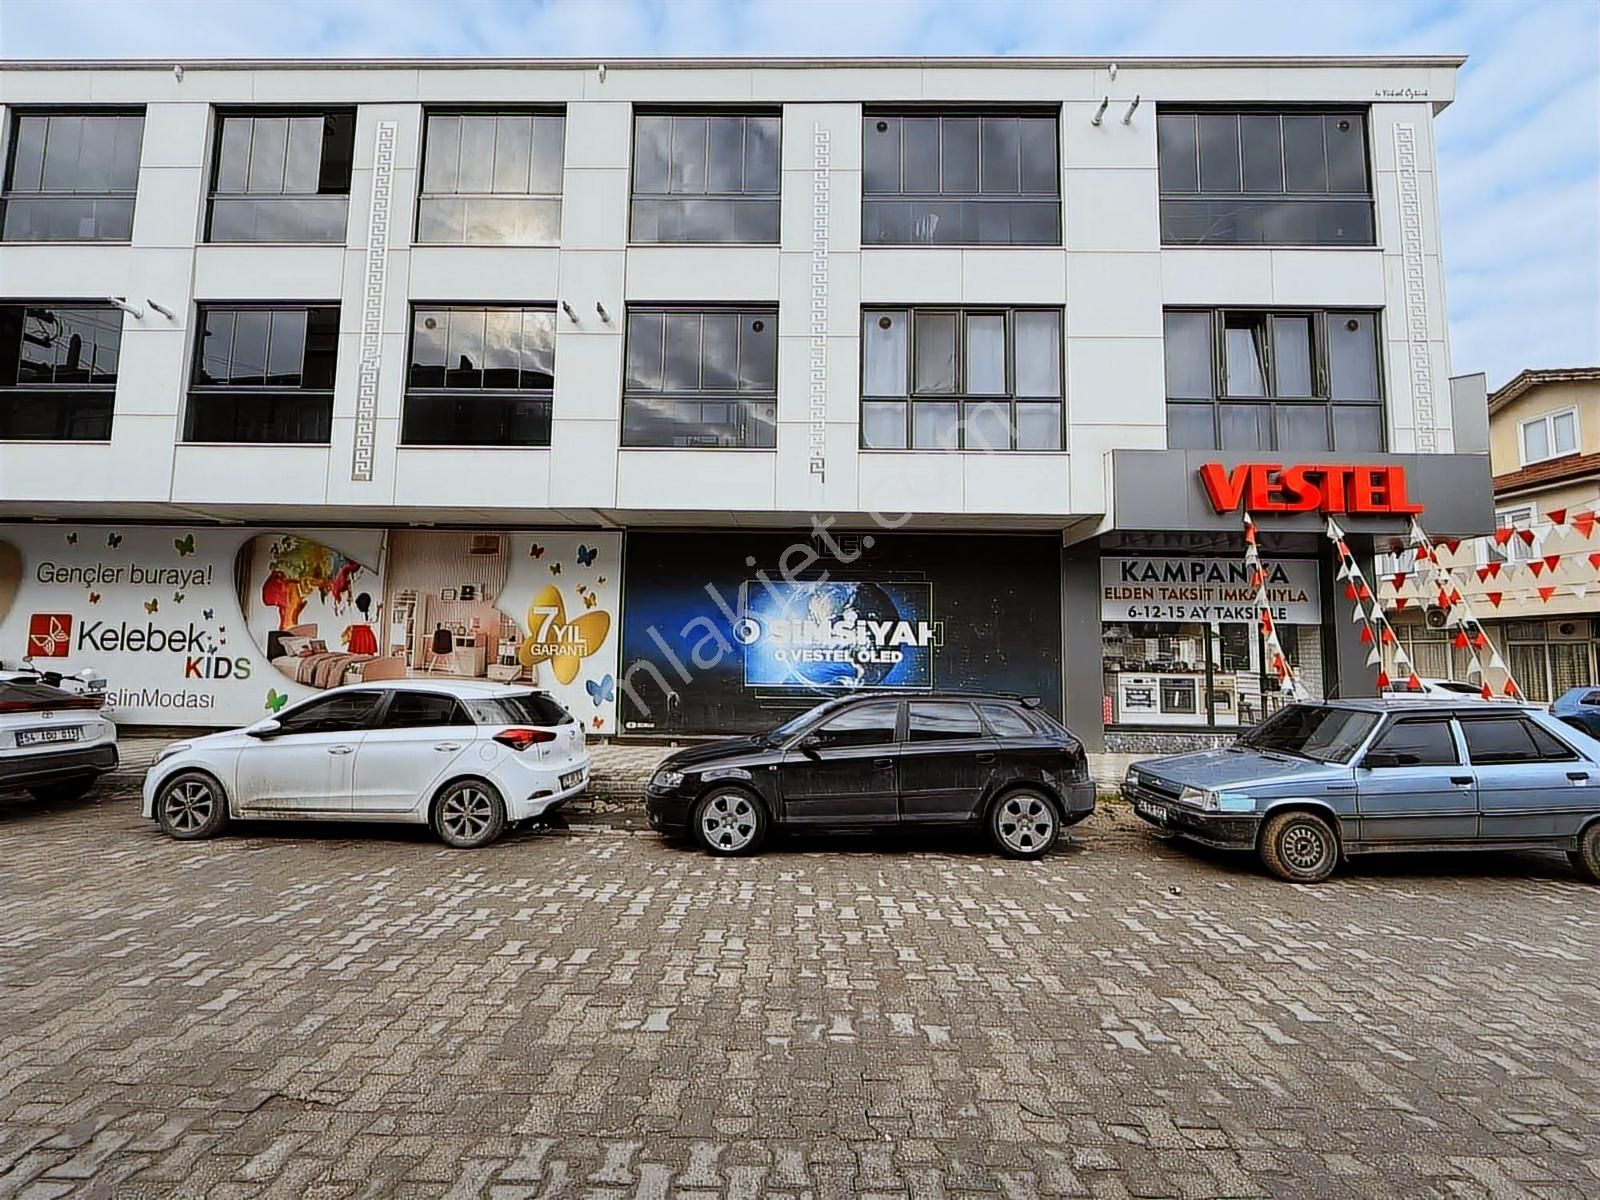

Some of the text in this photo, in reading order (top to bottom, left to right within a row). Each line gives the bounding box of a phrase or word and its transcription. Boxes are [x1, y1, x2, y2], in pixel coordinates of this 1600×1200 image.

[1199, 463, 1424, 514] VESTEL
[37, 562, 213, 589] Gençler buraya!
[1104, 587, 1154, 600] ELDEN
[1128, 605, 1186, 619] 6-12-15
[1190, 605, 1210, 619] AY
[533, 605, 587, 644] 7 YIL
[77, 621, 206, 653] Kelebek
[184, 656, 251, 680] KIDS
[775, 650, 904, 663] O VESTEL OLED
[105, 687, 216, 709] slinModası
